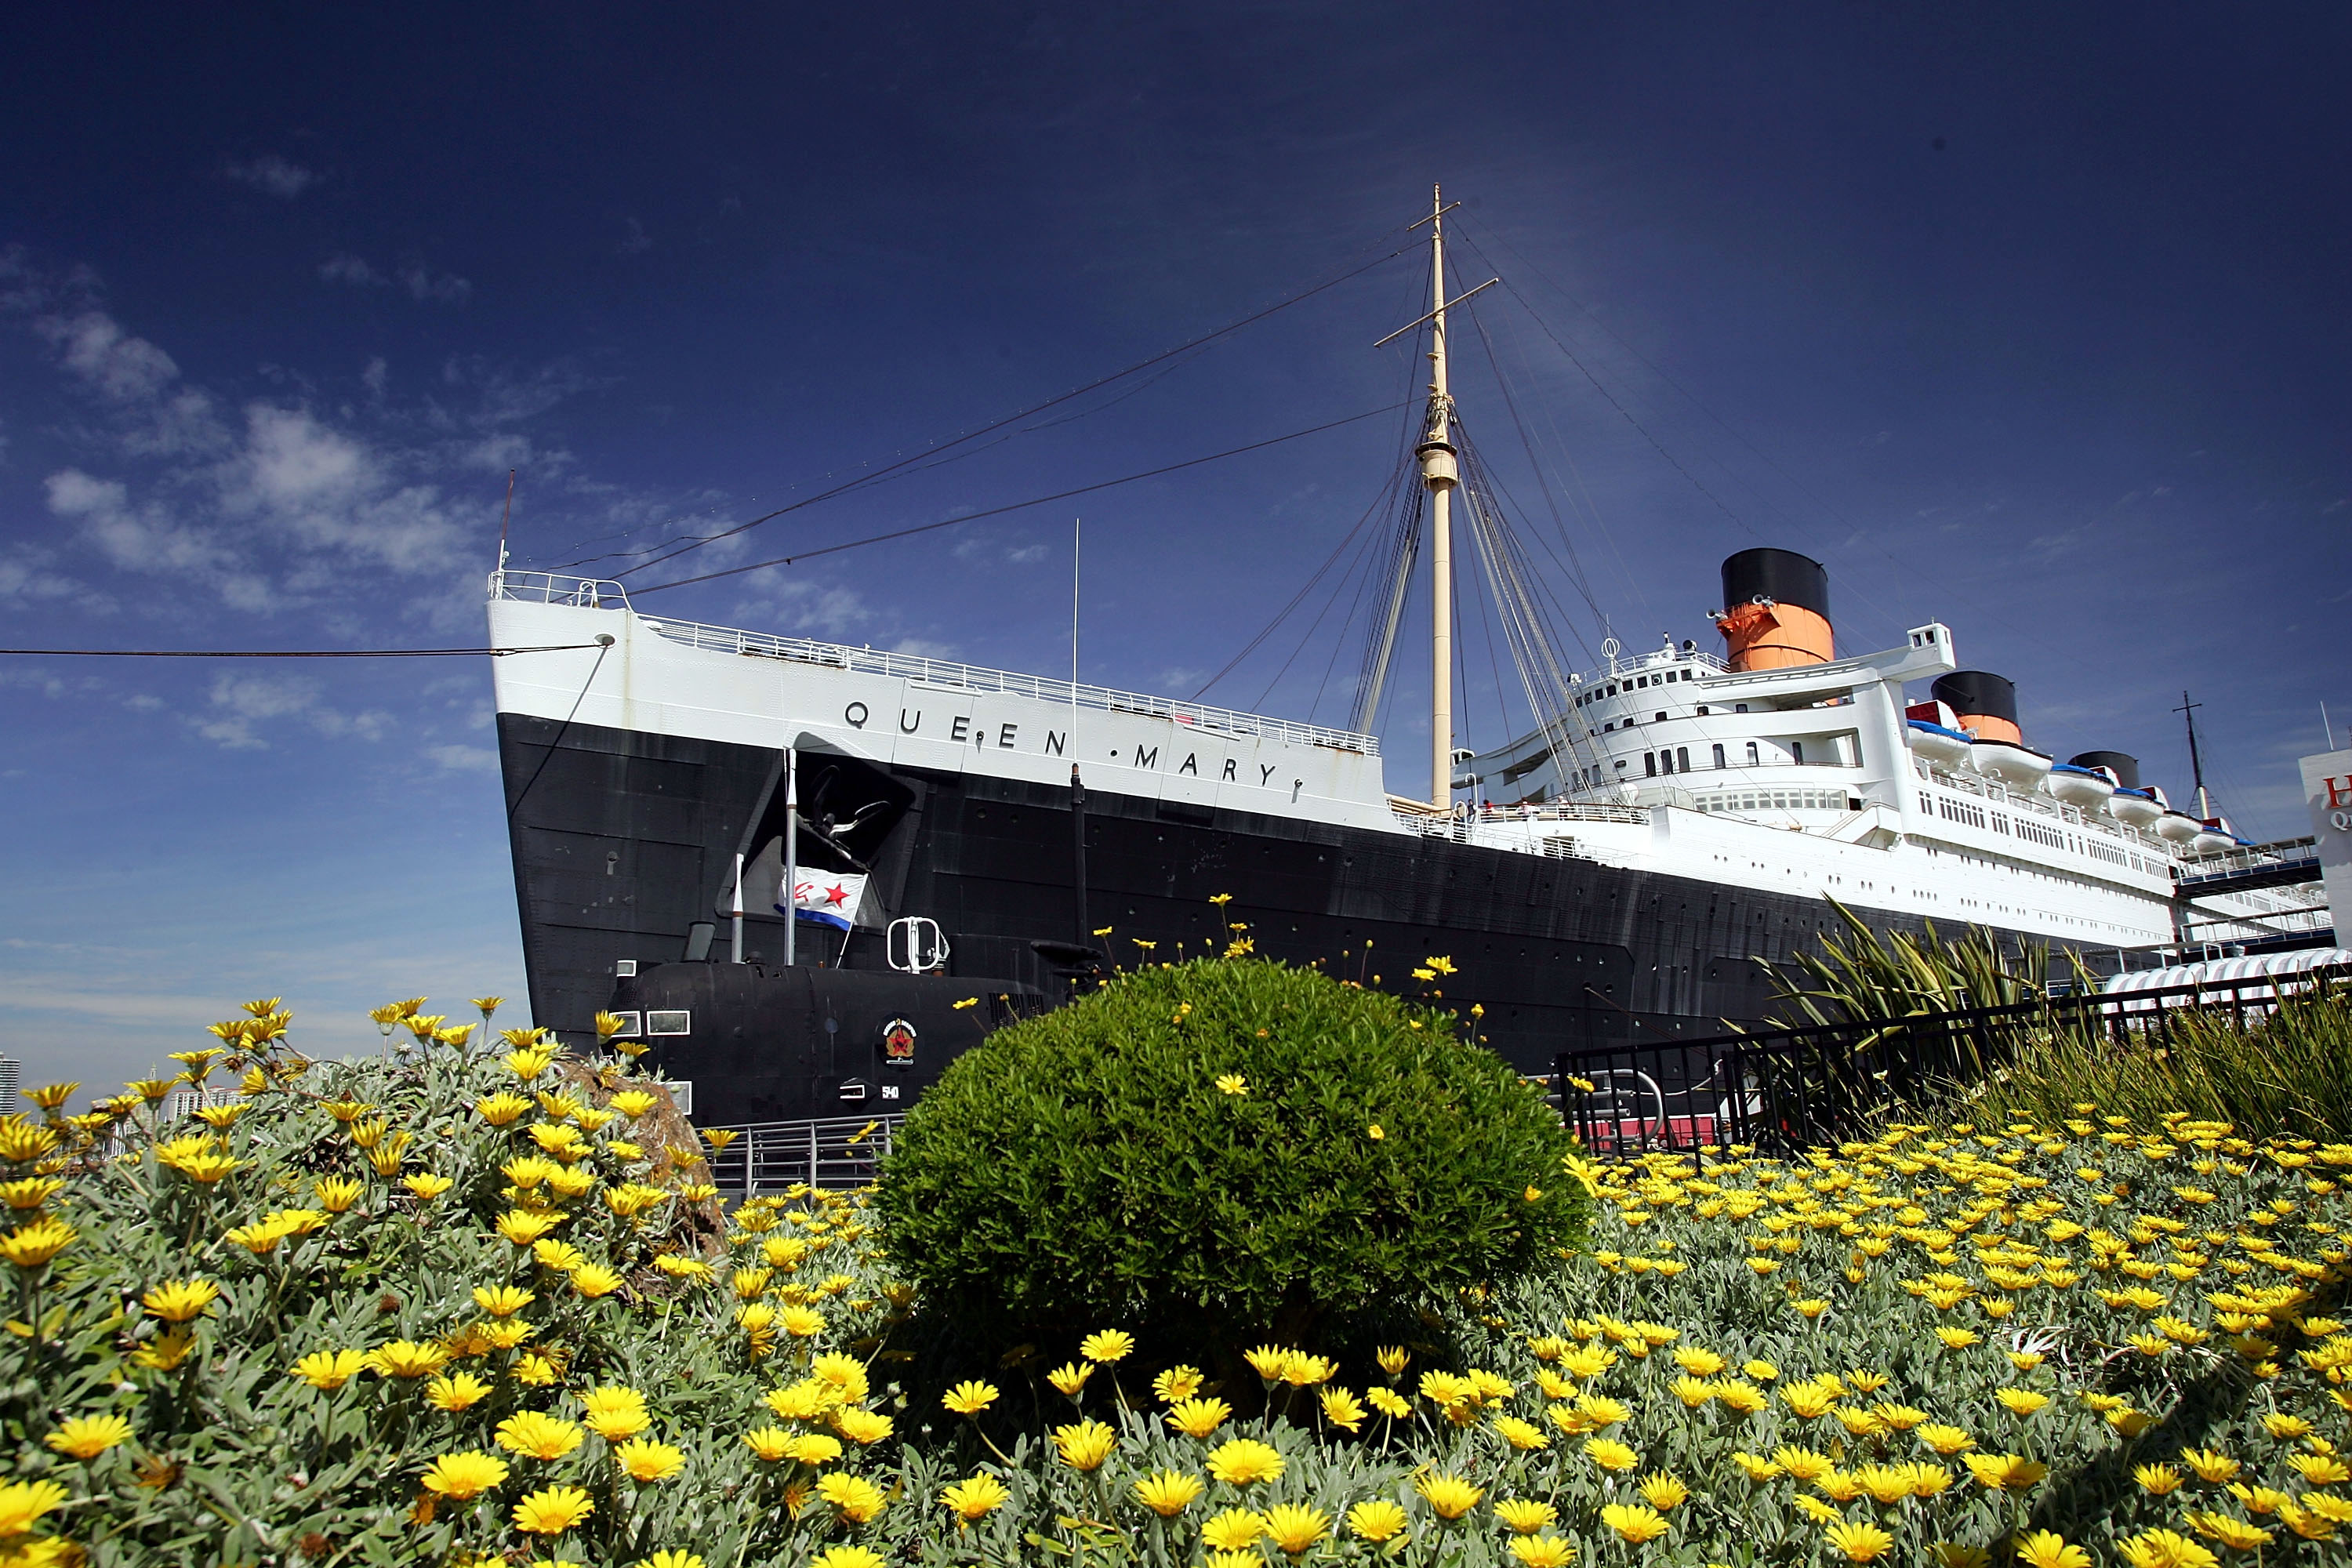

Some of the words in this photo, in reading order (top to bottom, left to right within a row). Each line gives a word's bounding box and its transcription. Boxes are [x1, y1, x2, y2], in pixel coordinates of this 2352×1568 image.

[845, 702, 1067, 757] QUEEN
[1134, 744, 1276, 786] MARY
[882, 1086, 898, 1098] 540
